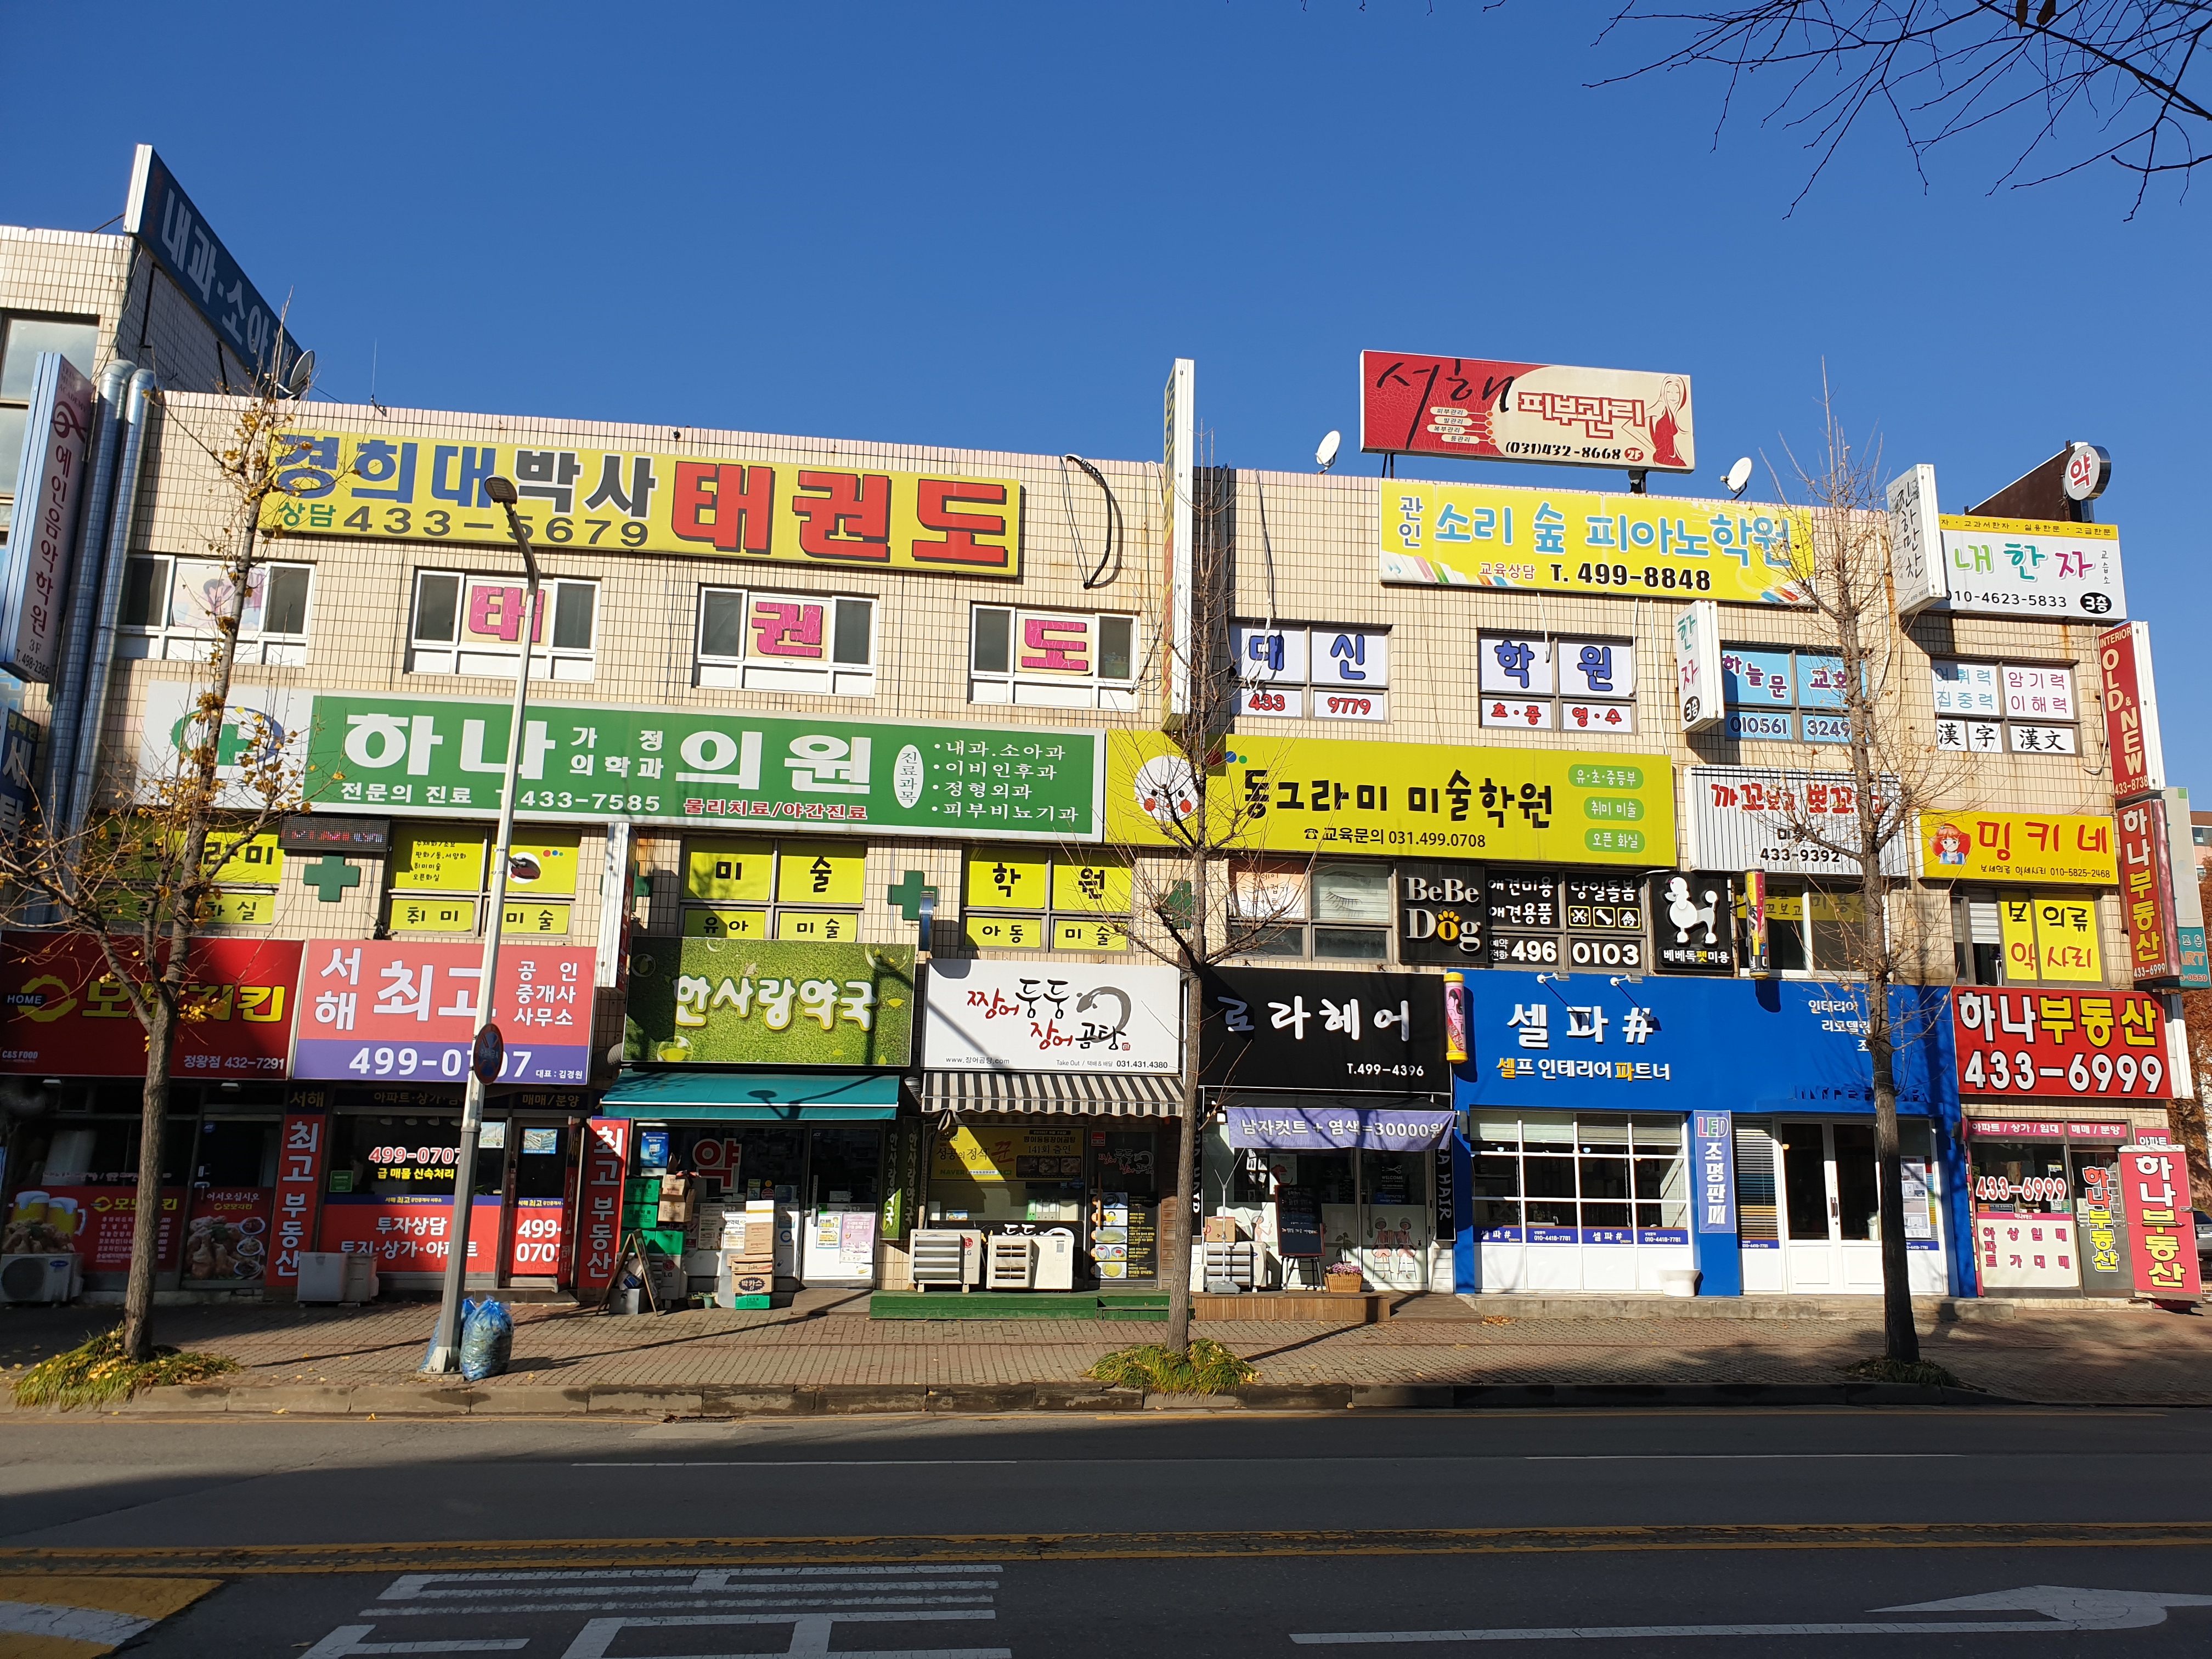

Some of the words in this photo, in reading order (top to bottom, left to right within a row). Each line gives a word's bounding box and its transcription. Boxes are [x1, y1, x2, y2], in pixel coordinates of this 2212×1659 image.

[1517, 391, 1645, 439] 피부관리
[1505, 441, 1622, 461] (031)432-8668
[1625, 449, 1643, 461] 2F
[2068, 451, 2094, 489] 약
[277, 501, 337, 528] 상담
[343, 505, 649, 548] 433-5679
[671, 461, 1008, 568] 태권도
[1964, 520, 2010, 530] 교과서한자
[31, 444, 72, 639] 예인음악학원
[1398, 495, 1424, 548] 관인
[1435, 502, 1513, 546] 소리
[1532, 500, 1566, 555] 숲
[1585, 512, 1791, 568] 피아노학원
[1479, 562, 1536, 580] 교육상담
[1577, 562, 1712, 591] 499-8848
[1945, 590, 2068, 608] 010-4623-5833
[2084, 595, 2109, 612] 3층
[751, 601, 823, 658] 권
[2099, 625, 2133, 648] INTERIOR
[29, 638, 42, 654] 3F
[1020, 618, 1089, 671] 도
[1677, 613, 1699, 693] 한자
[1722, 653, 1788, 700] 하늘문
[1934, 665, 1992, 686] 어휘력
[2007, 672, 2066, 690] 암기력
[1247, 693, 1286, 712] 433
[1327, 696, 1372, 716] 9779
[1937, 690, 1994, 710] 집중력
[2011, 695, 2068, 714] 이해력
[2102, 649, 2124, 712] OLD
[2121, 707, 2143, 776] NEW
[342, 713, 557, 780] 하나
[2019, 727, 2067, 751] 漢文
[569, 754, 664, 780] 의학과
[675, 730, 872, 794] 의원
[945, 760, 1059, 782] 이비인후과
[900, 751, 919, 805] 진료과목
[944, 780, 1034, 800] 정형외과
[2114, 775, 2149, 797] 433-8738
[341, 782, 413, 804] 전문의
[426, 786, 472, 805] 진료
[1243, 769, 1389, 819] 동그라미
[1407, 769, 1553, 829] 미술학원
[683, 797, 869, 821] 물리치료/야간진료
[943, 800, 1080, 823] 피부비뇨기과
[1590, 799, 1612, 816] 취미
[1616, 799, 1637, 818] 미술
[1323, 826, 1385, 845] 교육문의
[1388, 830, 1486, 849] 031.499.0708
[1592, 832, 1613, 848] 오픈
[1617, 833, 1639, 850] 화실
[1977, 821, 2108, 861] 밍키네
[1759, 848, 1840, 863] 433-9392
[1980, 864, 2011, 875] 보세의류
[2015, 866, 2046, 877] 악세사리
[2050, 867, 2111, 878] 010-5825-2468
[1404, 876, 1480, 903] BeBe
[1487, 876, 1554, 898] 애견미용
[1571, 878, 1637, 903] 당일돌봄
[2123, 808, 2160, 962] 하나부동산
[1489, 902, 1553, 925] 애견용품
[1406, 907, 1481, 952] Dog
[1511, 940, 1558, 962] 496
[1572, 941, 1640, 966] 0103
[1663, 948, 1731, 964] 베베독펫미용
[517, 960, 578, 982] 공인
[2133, 962, 2166, 979] 433-6999
[7, 994, 43, 1005] HOME
[515, 984, 577, 1005] 중개사
[673, 974, 877, 1032] 한사랑약국
[513, 1007, 574, 1028] 사무소
[1958, 990, 2158, 1048] 하나부동산
[18, 1051, 38, 1060] FOOD
[183, 1054, 221, 1069] 정왕점
[224, 1057, 285, 1070] 432-7291
[1056, 1059, 1070, 1067] Take
[1070, 1059, 1080, 1067] Out
[1116, 1060, 1169, 1069] 031.431.4380
[558, 1070, 584, 1080] 김경원
[1496, 1056, 1536, 1080] 셀프
[1538, 1058, 1613, 1080] 인테리어
[1614, 1060, 1672, 1082] 파트너
[1963, 1049, 2163, 1094] 433-6999
[290, 1091, 325, 1108] 서해
[1240, 1119, 1310, 1137] 남자컷트
[1697, 1116, 1729, 1138] LED
[1972, 1123, 2001, 1133] 아파트
[2011, 1123, 2031, 1134] 상가
[2040, 1123, 2059, 1134] 임대
[2070, 1124, 2090, 1134] 매매
[2100, 1125, 2120, 1135] 분양
[282, 1120, 319, 1182] 최고
[936, 1147, 966, 1161] 성공의
[966, 1147, 989, 1161] 정석
[414, 1169, 455, 1180] 신속처리
[692, 1138, 742, 1194] 약
[1704, 1142, 1727, 1226] 조명판매
[1975, 1175, 2067, 1202] 433-6999
[206, 1192, 261, 1203] 어서오십시오
[1438, 1173, 1453, 1221] HAIR
[375, 1217, 448, 1236] 투자상담
[2082, 1166, 2119, 1272] 하나부동산
[2135, 1154, 2186, 1289] 하나부동산
[275, 1192, 307, 1277] 부동산
[586, 1197, 614, 1278] 부동산
[1982, 1226, 1998, 1268] 아파트
[741, 1279, 763, 1288] 박카스
